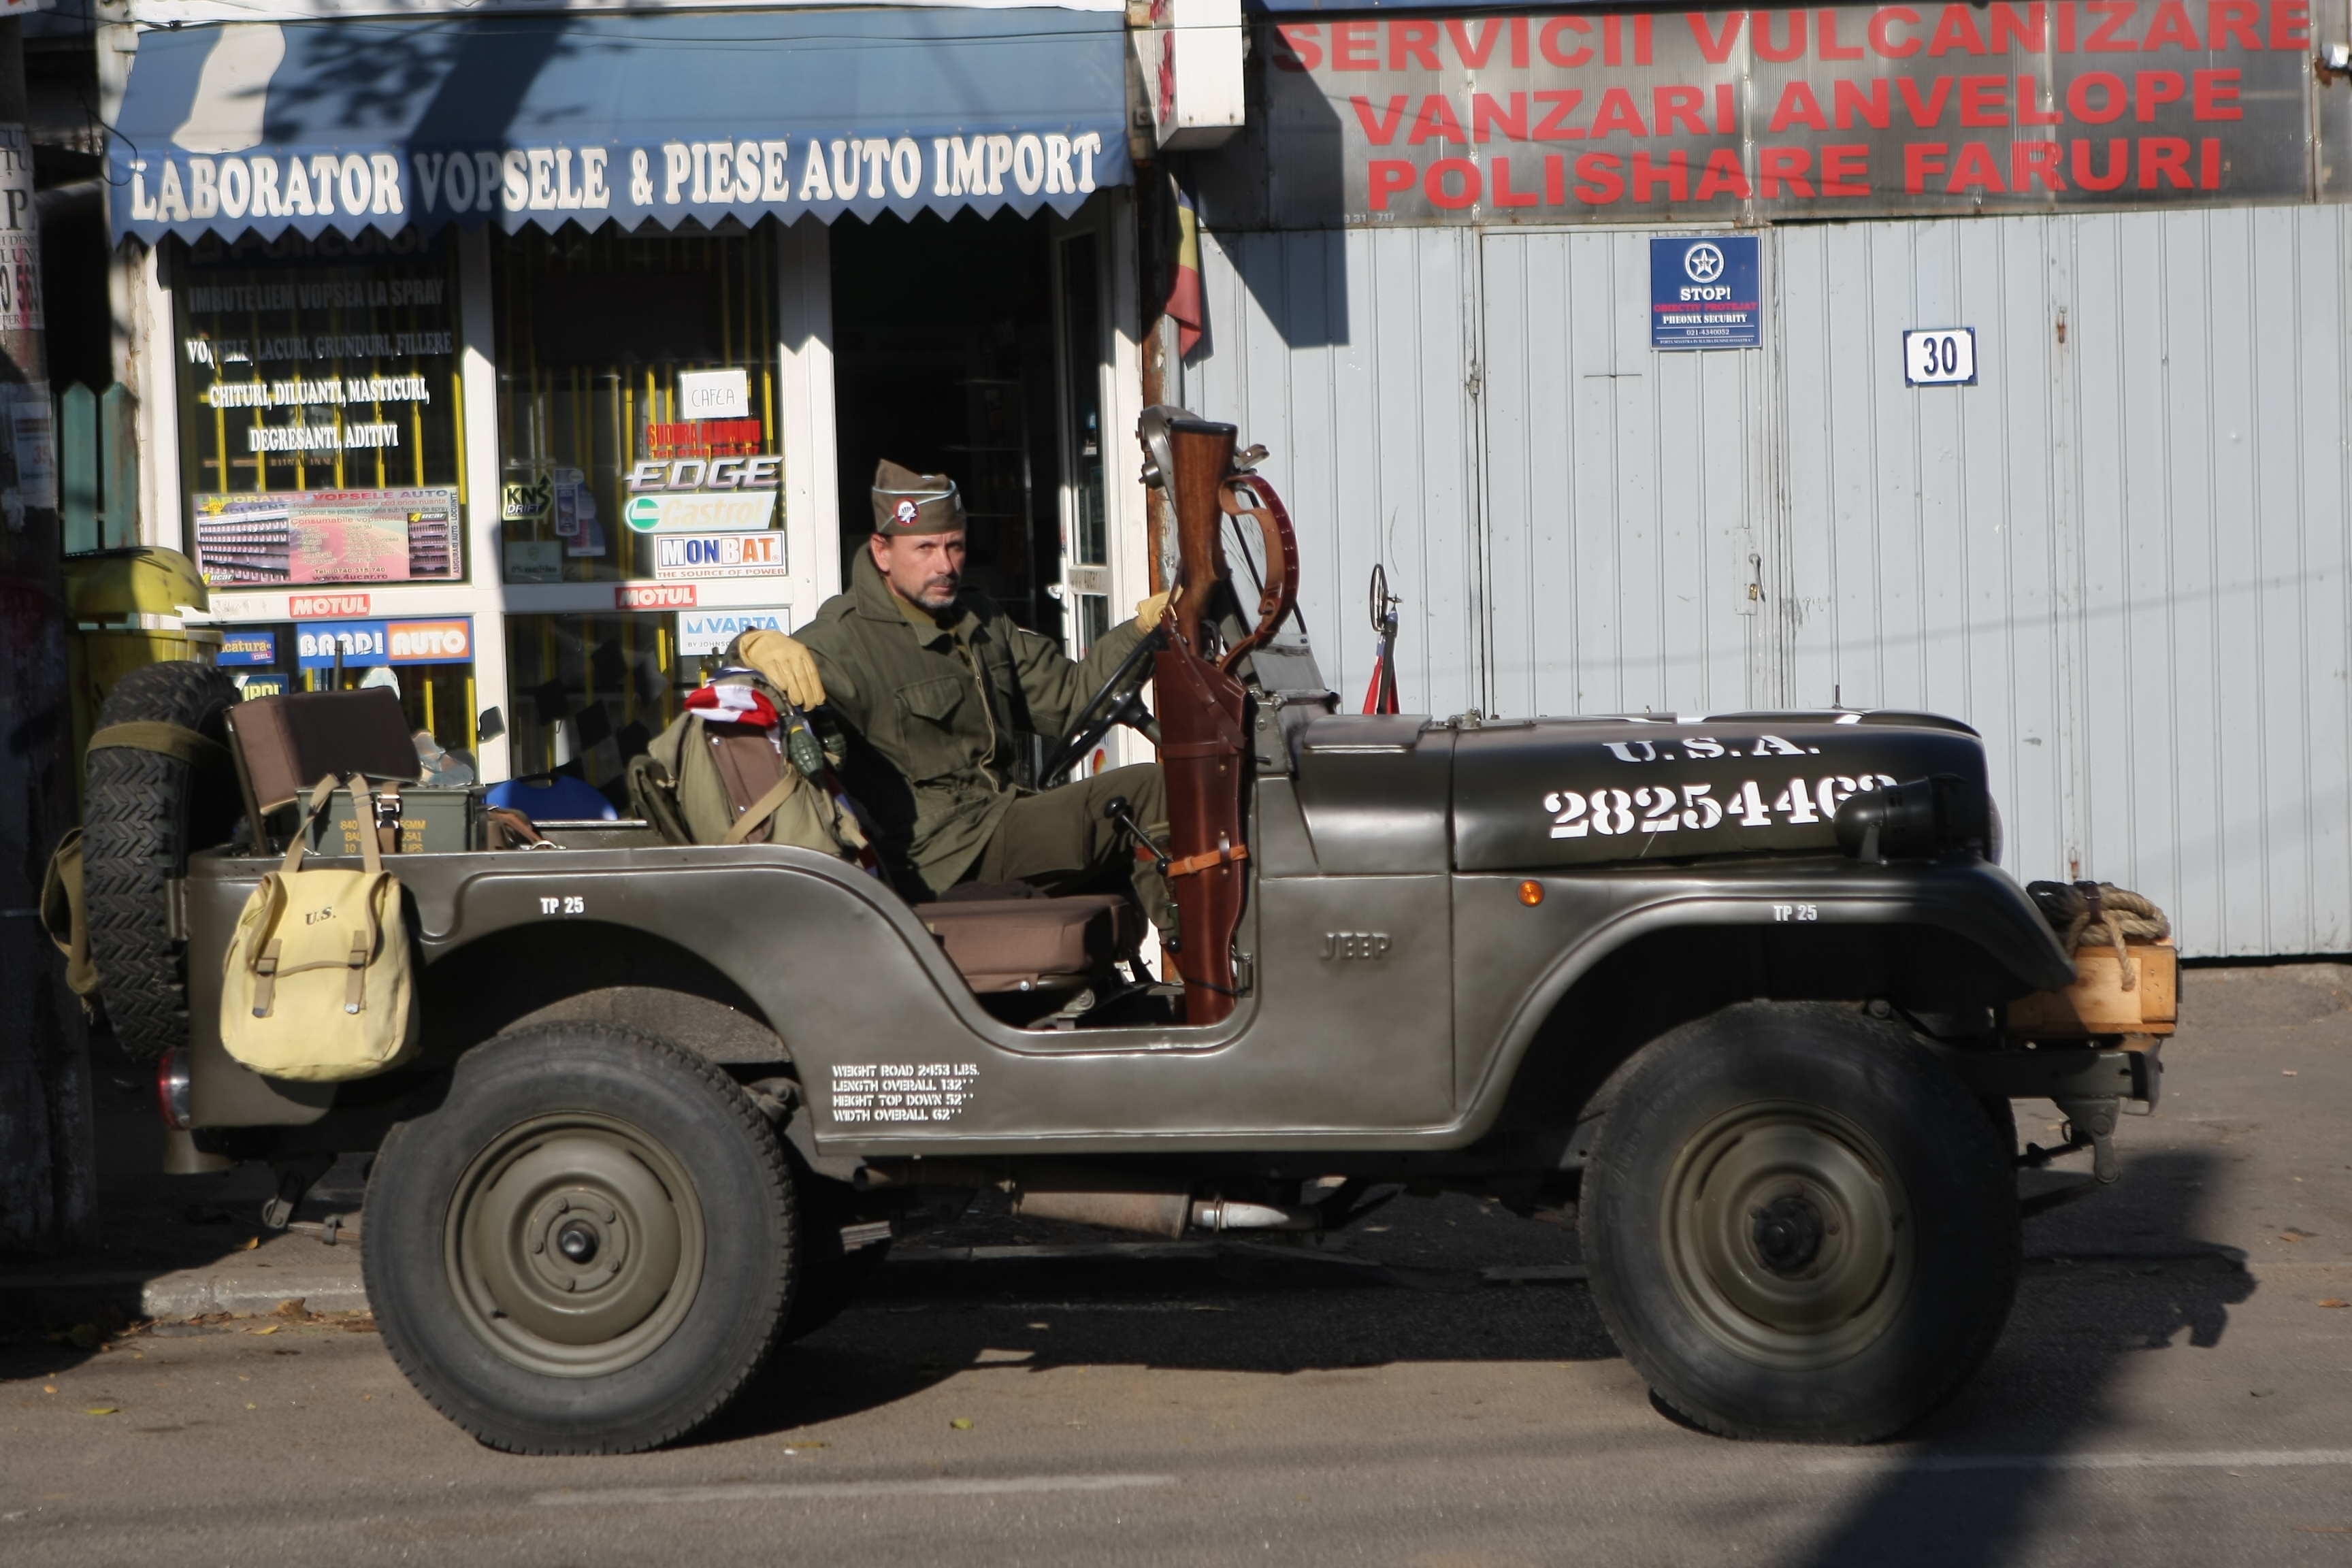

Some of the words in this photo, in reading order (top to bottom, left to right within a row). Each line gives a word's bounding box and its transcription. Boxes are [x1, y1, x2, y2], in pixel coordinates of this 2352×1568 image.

[1271, 13, 1653, 72] SERVICII
[1686, 0, 2310, 65] VULCANIZARE
[1350, 84, 1737, 146] VANZARI
[1769, 69, 2244, 131] ANVELOPE
[131, 151, 404, 223] LABORATOR
[413, 147, 610, 214] VOPSELE
[631, 149, 654, 206] &
[664, 142, 790, 204] PIESE
[800, 138, 923, 201] AUTO
[934, 133, 1102, 197] IMPORT
[1369, 145, 1871, 211] POLISHARE
[1906, 139, 2221, 195] FARURI
[299, 282, 365, 310] VOPSEA
[368, 281, 388, 307] LA
[391, 280, 444, 306] SPRAY
[1680, 287, 1731, 301] STOP!
[1654, 304, 1701, 312] OBIECTIV
[1704, 302, 1757, 311] PROTEJAT
[1663, 315, 1702, 324] PHEONIX
[1703, 314, 1747, 323] SECURITY
[1923, 336, 1958, 377] 30
[209, 383, 272, 410] CHITURI,
[275, 380, 346, 408] DILUANTI,
[348, 378, 430, 404] MASTICURI,
[691, 388, 735, 408] CAFEA
[250, 426, 343, 453] DEGRESANTI,
[345, 423, 399, 449] ADITIVI
[647, 422, 698, 446] SUDURA
[623, 457, 783, 491] EDGE
[197, 493, 306, 504] LABORATOR
[313, 491, 394, 501] VOPSELE
[400, 490, 448, 498] AUTO
[208, 503, 224, 511] NOU
[507, 504, 542, 514] DRIFT
[662, 497, 766, 527] Castrol
[291, 517, 353, 525] Consumabile
[410, 512, 446, 523] 4ucar
[660, 537, 776, 566] MONBAT
[293, 596, 368, 616] MOTUL
[619, 587, 694, 606] MOTUL
[706, 617, 781, 634] VARTA
[299, 632, 384, 657] BARDI
[392, 630, 467, 656] AUTO
[340, 820, 358, 830] 840
[540, 897, 559, 915] TP
[564, 896, 585, 914] 25
[1774, 905, 1793, 921] TP
[1797, 904, 1818, 921] 25
[305, 905, 337, 926] U.S.
[1319, 932, 1392, 960] JEEP
[832, 1064, 877, 1077] WEIGHT
[881, 1064, 914, 1077] ROAD
[832, 1079, 879, 1092] LENGTH
[882, 1079, 937, 1092] OVERALL
[832, 1094, 875, 1107] HEIGHT
[878, 1094, 902, 1107] TOP
[906, 1093, 942, 1106] DOWN
[832, 1109, 870, 1122] WIDTH
[874, 1108, 929, 1121] OVERALL
